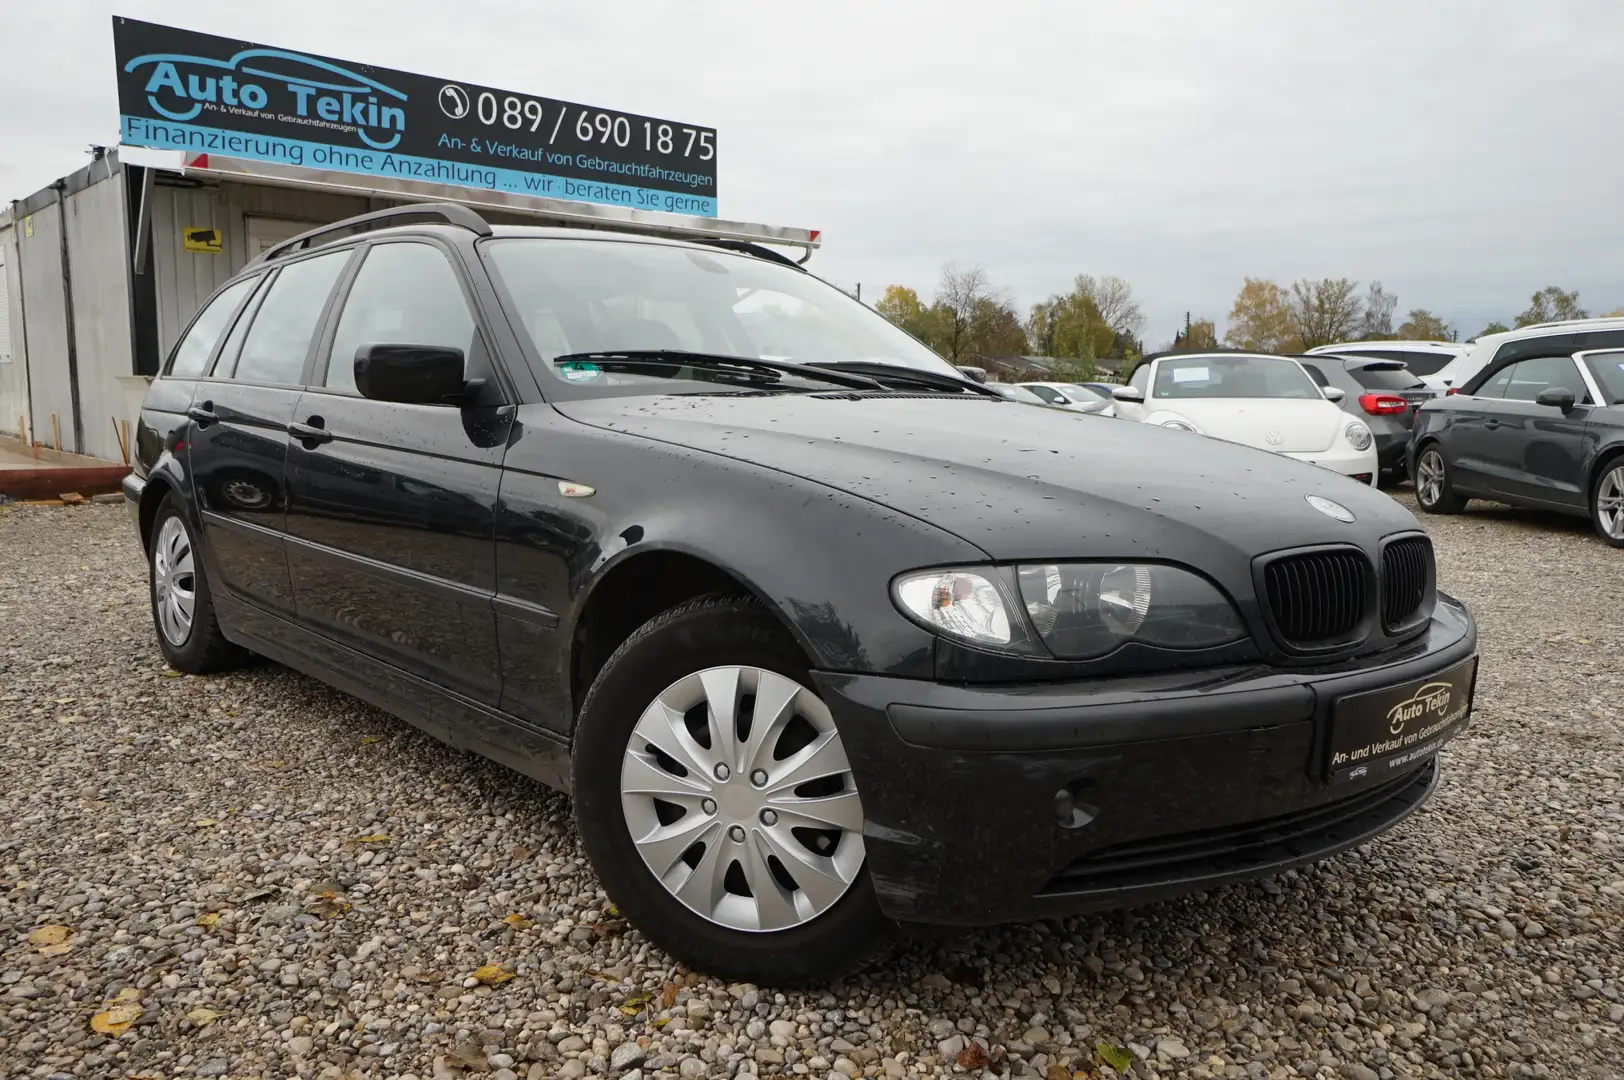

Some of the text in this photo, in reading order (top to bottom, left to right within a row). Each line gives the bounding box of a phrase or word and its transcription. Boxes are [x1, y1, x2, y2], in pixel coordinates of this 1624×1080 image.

[145, 62, 405, 131] Auto Tekin
[203, 102, 357, 133] An- & Verkauf von Gebrauchtfahrzeugen
[477, 92, 714, 160] 089 / 690 18 75
[127, 117, 304, 166] Finanzierung
[312, 146, 374, 170] ohne
[380, 154, 496, 190] Anzahlung
[523, 175, 553, 192] wir
[564, 178, 632, 204] beraten
[637, 190, 660, 208] Sie
[664, 197, 710, 213] gerne
[437, 133, 713, 187] An- & Verkauf von Gebrauchtfahrzeugen
[1392, 691, 1451, 724] Auto Tekin
[1332, 751, 1349, 766] An-
[1351, 745, 1369, 761] und
[1372, 735, 1402, 755] Verkauf
[1404, 731, 1418, 746] von
